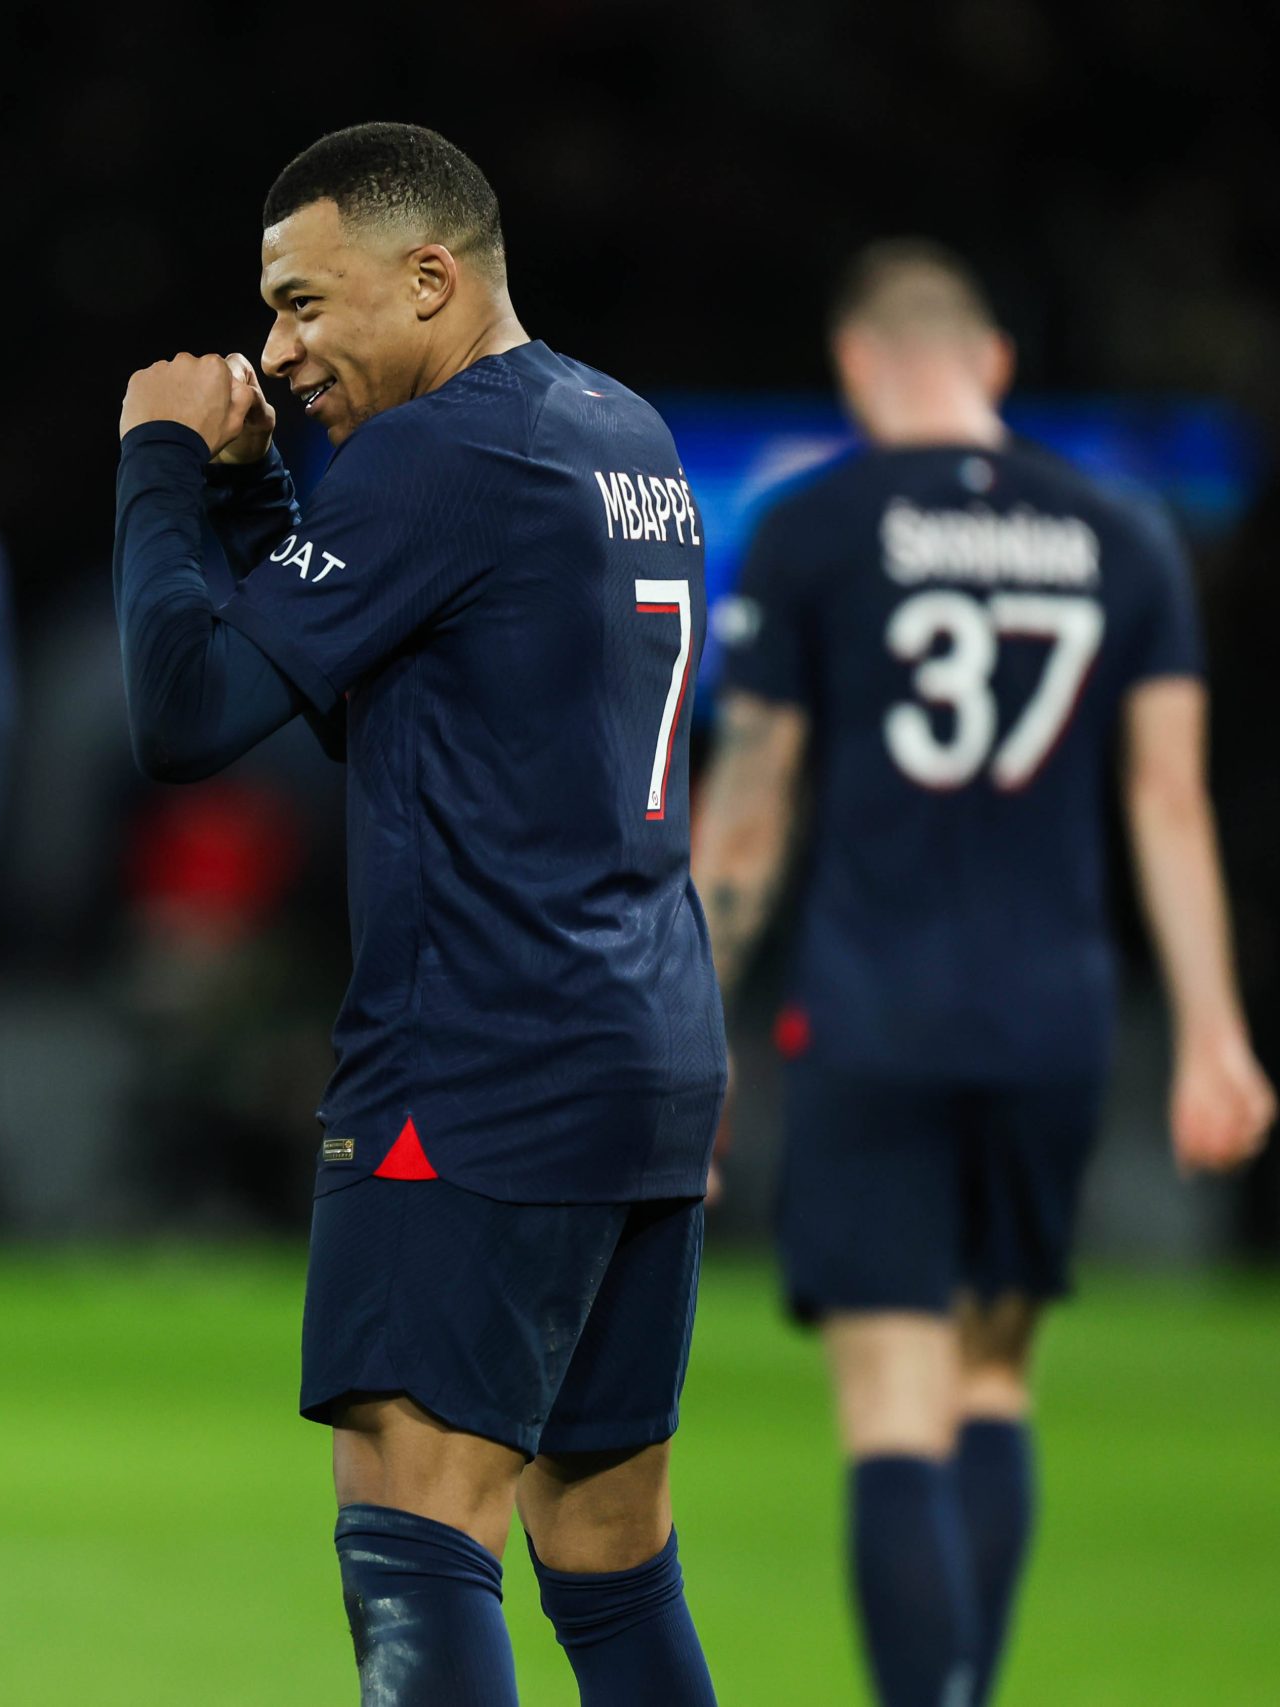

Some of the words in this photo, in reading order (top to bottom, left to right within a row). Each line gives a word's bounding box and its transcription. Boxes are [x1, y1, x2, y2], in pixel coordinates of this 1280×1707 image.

[594, 467, 700, 546] MBAPPÉ
[634, 579, 693, 820] 7
[885, 590, 1106, 789] 37
